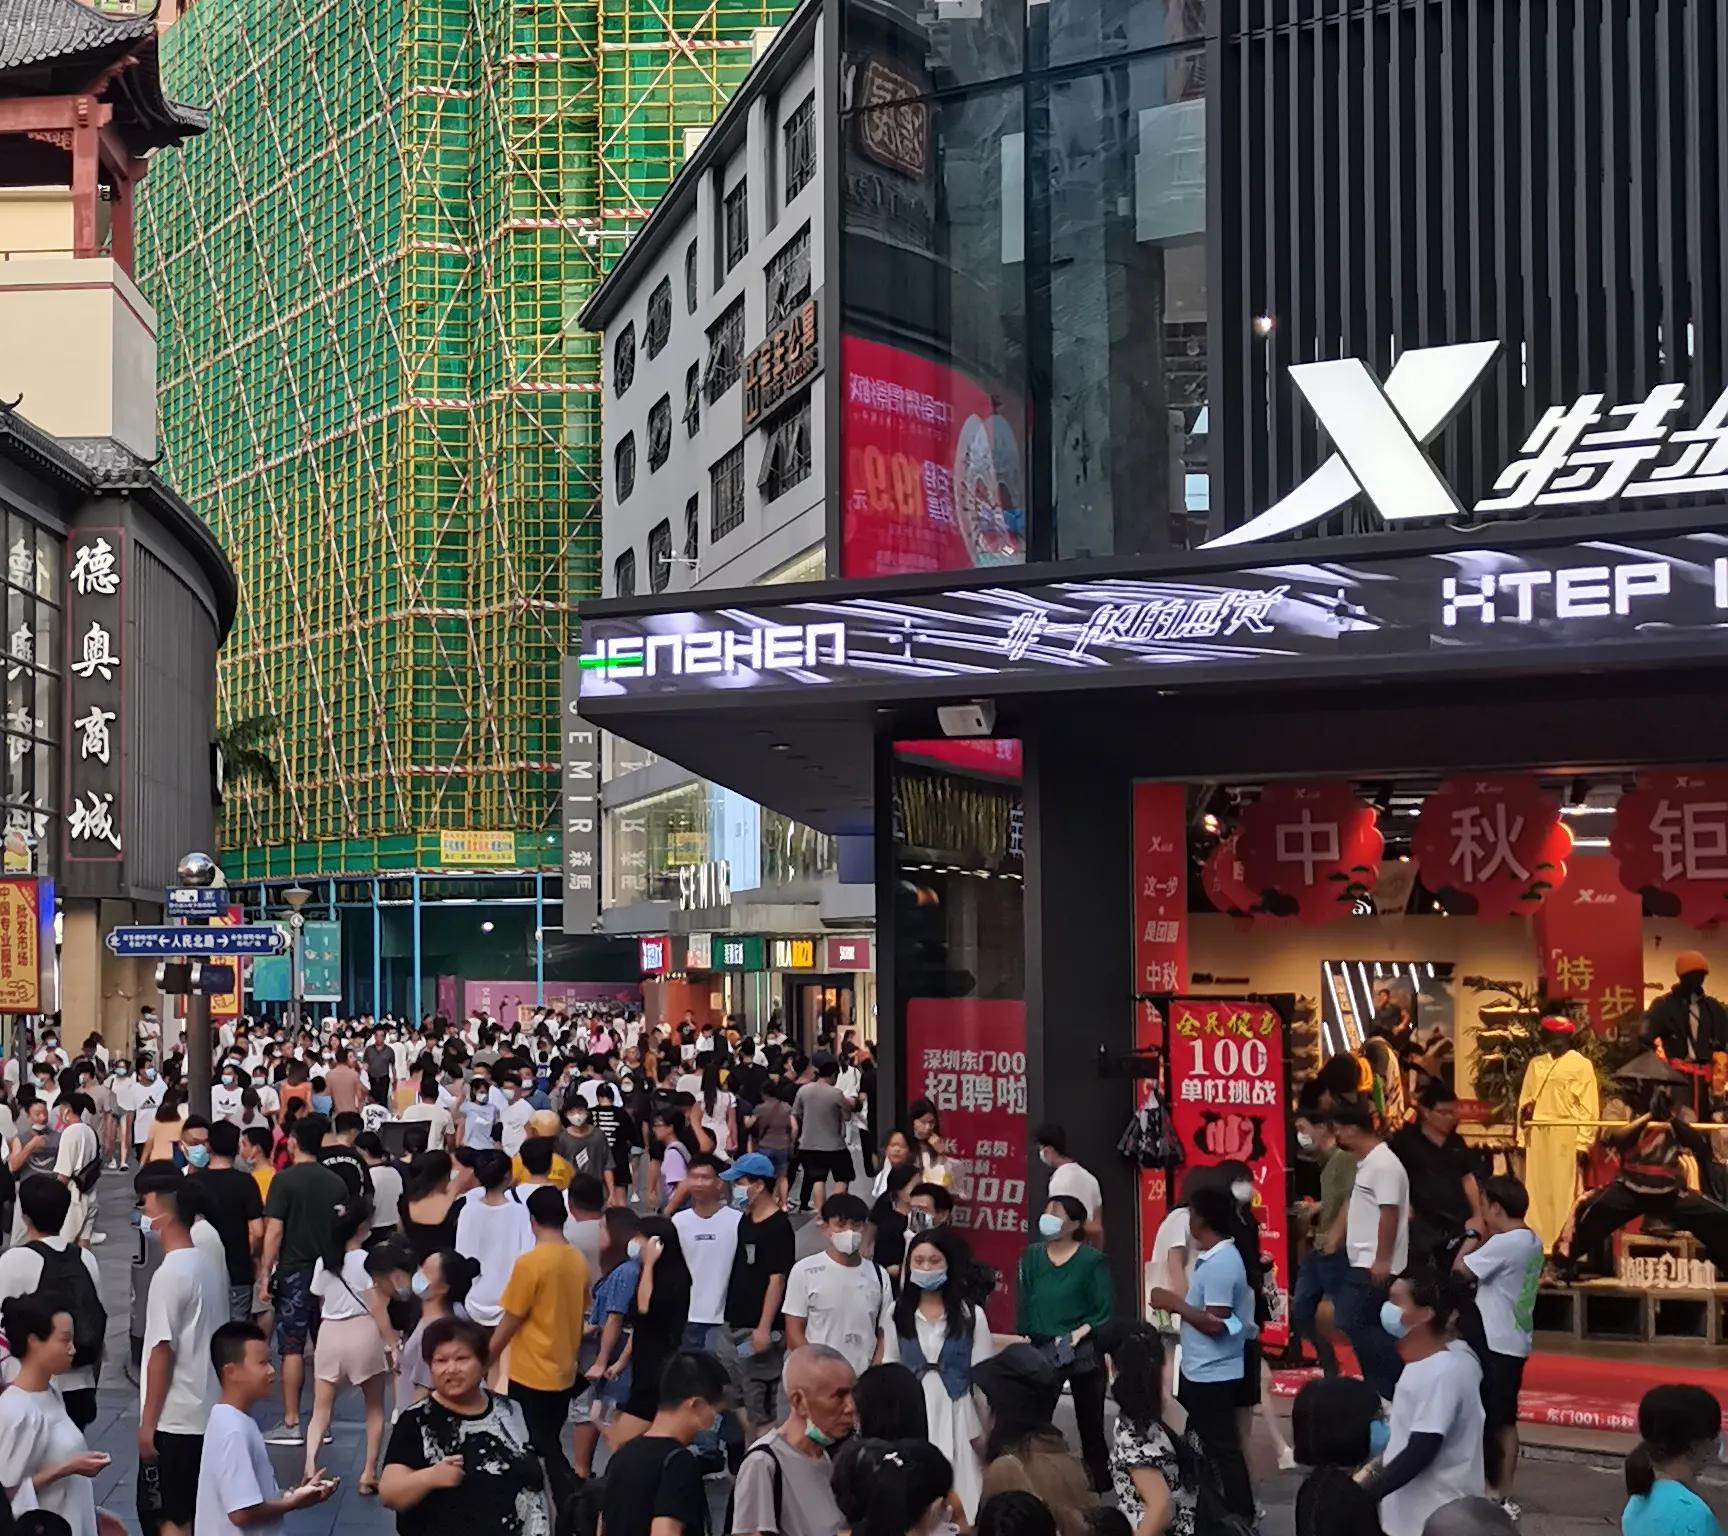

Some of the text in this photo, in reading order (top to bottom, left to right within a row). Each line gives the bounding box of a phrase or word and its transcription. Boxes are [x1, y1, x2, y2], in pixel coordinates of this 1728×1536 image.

[69, 536, 123, 852] 德奥商城
[678, 859, 732, 911] SEMIR
[1145, 961, 1180, 991] 中秋
[1187, 1036, 1270, 1077] 100
